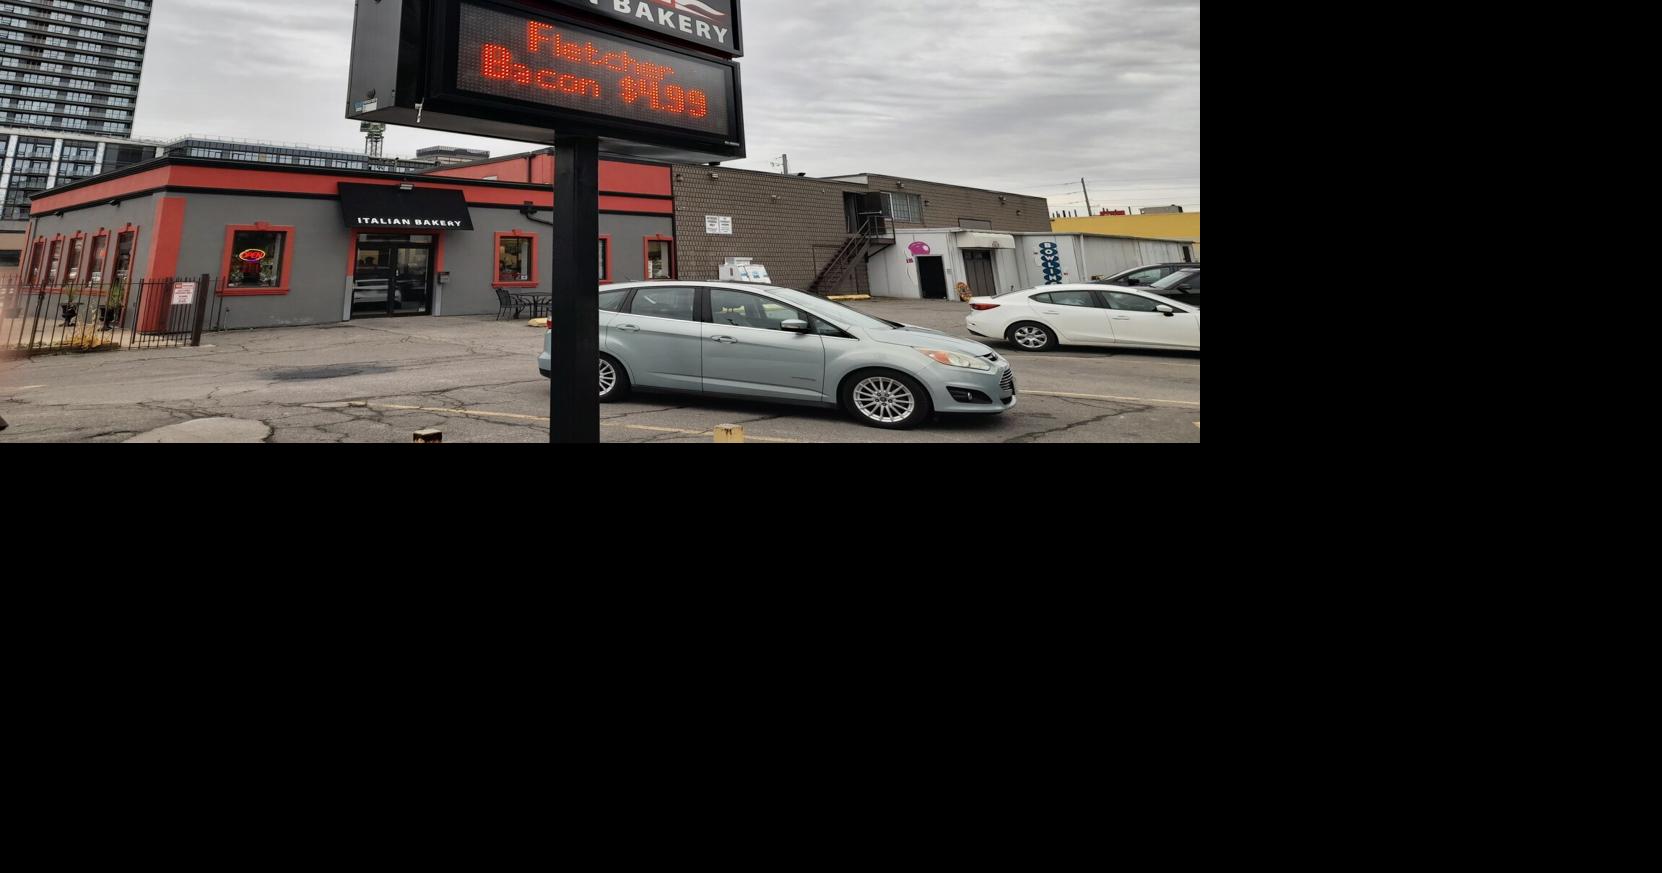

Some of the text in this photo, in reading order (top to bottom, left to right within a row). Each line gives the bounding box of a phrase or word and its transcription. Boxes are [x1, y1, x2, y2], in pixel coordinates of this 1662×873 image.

[613, 0, 728, 43] BAKERY
[482, 43, 707, 117] Bacon $4.99
[357, 217, 461, 227] ITALIAN BAKERY
[243, 251, 264, 260] OPEN
